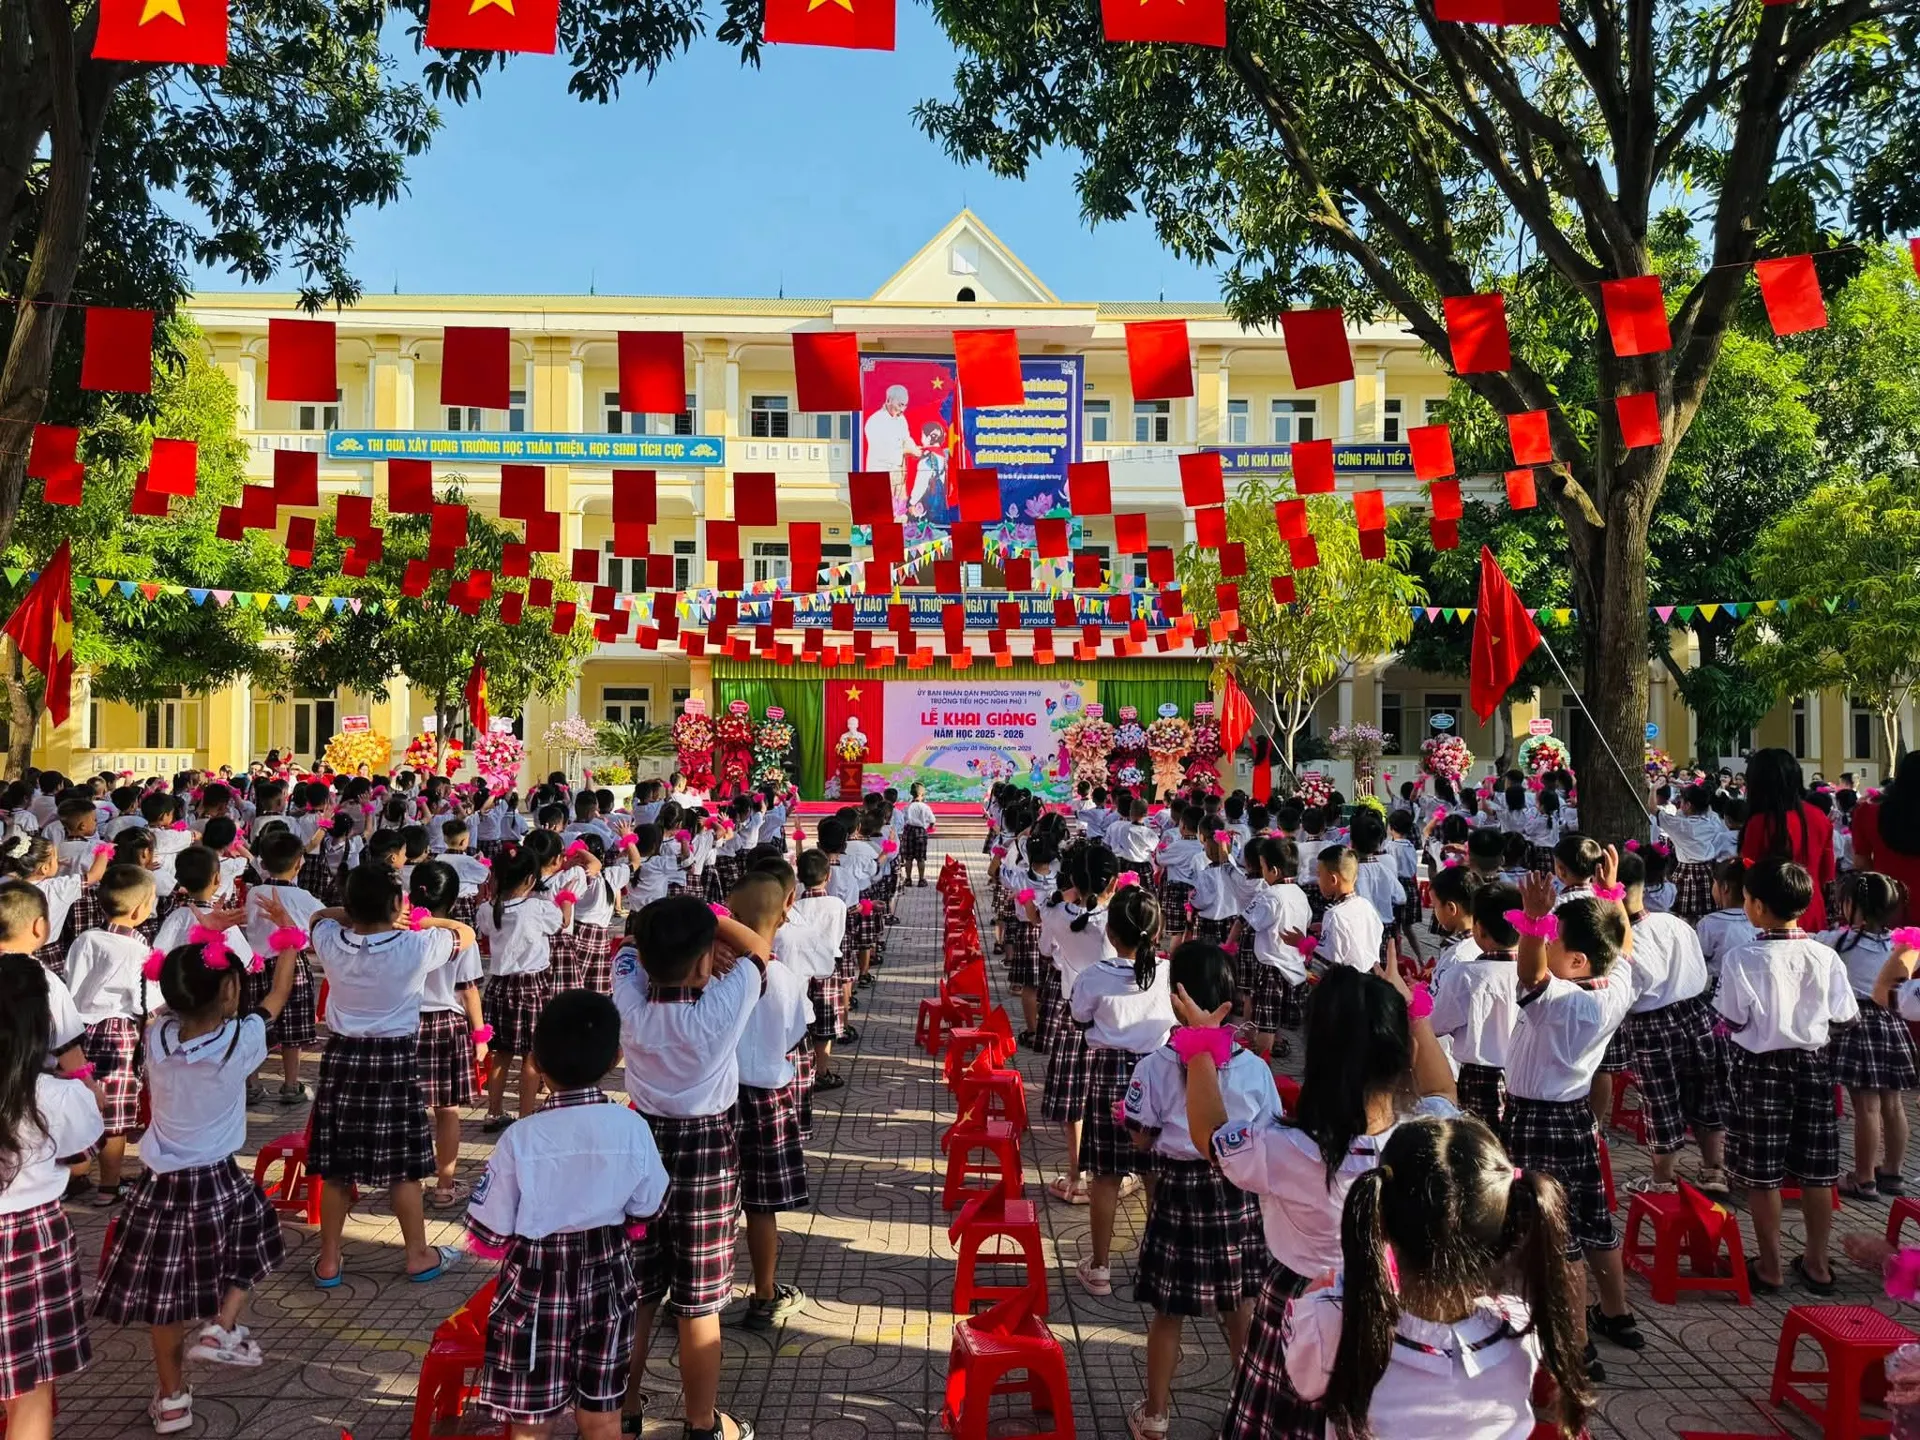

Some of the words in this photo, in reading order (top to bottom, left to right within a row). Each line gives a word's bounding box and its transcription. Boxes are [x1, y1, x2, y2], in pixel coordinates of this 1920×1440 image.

[367, 439, 384, 452] THI
[385, 439, 406, 452] ĐUA
[407, 437, 428, 453] XÂY
[430, 439, 459, 455] DỰNG
[460, 438, 500, 454] TRƯỜNG
[502, 441, 524, 456] HỌC
[555, 440, 587, 458] THIỆN,
[589, 442, 610, 458] HỌC
[612, 443, 637, 456] SINH
[639, 441, 662, 457] TÍCH
[664, 443, 685, 459] CỰC
[1251, 451, 1270, 467] KHÓ
[1337, 451, 1362, 466] CŨNG
[1364, 449, 1385, 466] PHẢI
[1386, 449, 1406, 466] TIẾP
[878, 615, 888, 623] of
[1023, 616, 1049, 626] proud
[1079, 617, 1087, 625] in
[1089, 617, 1103, 625] the
[920, 707, 939, 726] LỄ
[943, 712, 981, 726] KHAI
[986, 708, 1037, 726] GIẢNG
[933, 728, 953, 739] NĂM
[955, 729, 973, 740] HỌC
[975, 729, 996, 739] 2025
[1003, 729, 1024, 739] 2026
